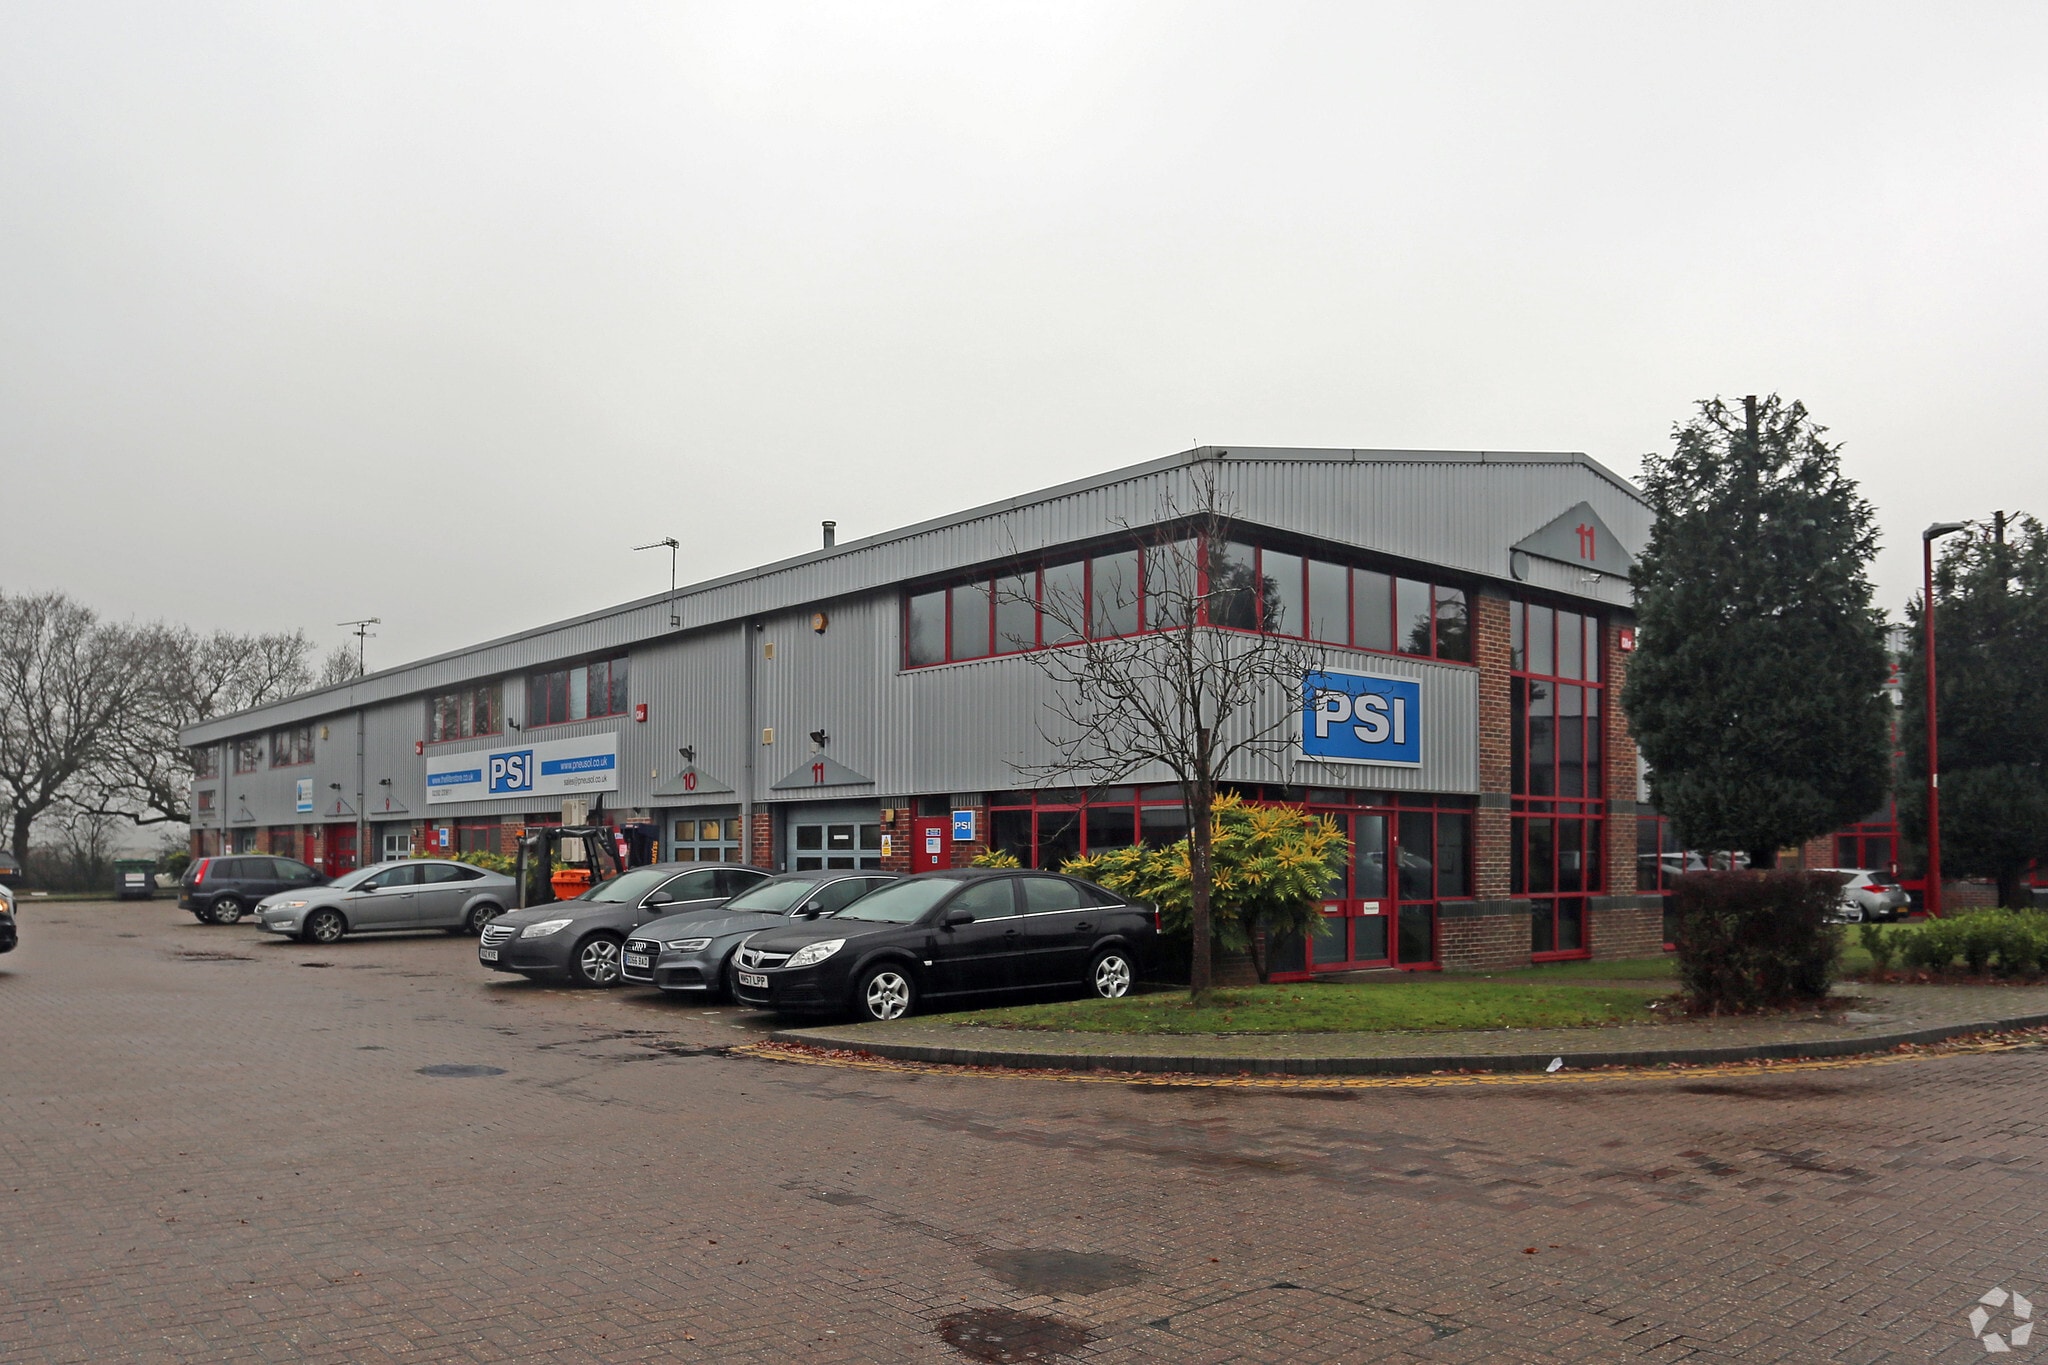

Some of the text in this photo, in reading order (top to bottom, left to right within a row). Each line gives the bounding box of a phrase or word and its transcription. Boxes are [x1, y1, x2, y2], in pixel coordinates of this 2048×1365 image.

[1575, 522, 1596, 561] 11
[1315, 689, 1406, 745] PSI
[560, 756, 608, 771] www.pneusol.co.uk
[490, 754, 531, 789] PSI
[812, 762, 825, 783] 11
[563, 775, 607, 786] sales@pneusol.co.uk
[682, 772, 697, 791] 10
[336, 801, 341, 813] 8
[385, 797, 390, 811] 9
[954, 821, 971, 830] PSI
[752, 975, 765, 986] LPP
